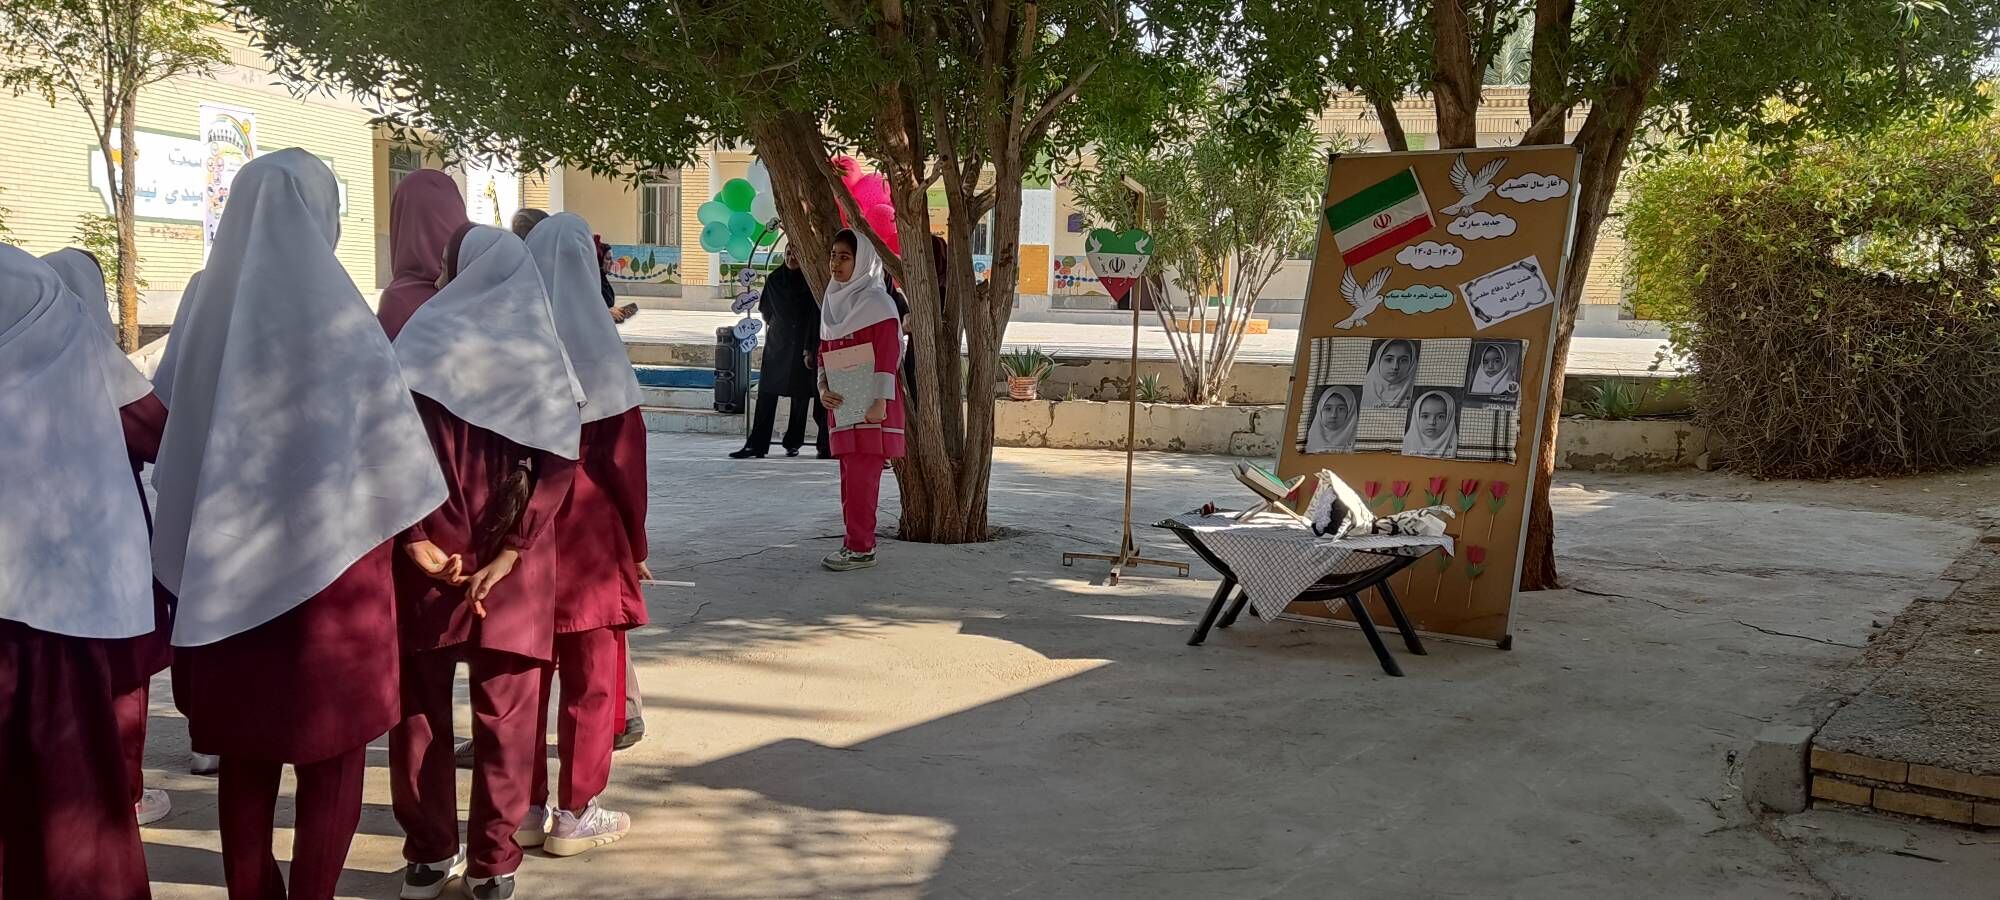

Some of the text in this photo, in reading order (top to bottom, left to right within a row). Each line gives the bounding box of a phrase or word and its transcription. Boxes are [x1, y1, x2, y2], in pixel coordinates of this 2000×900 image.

[1501, 179, 1562, 192] آغاز سال تحصیلی
[1481, 219, 1501, 228] جدید
[743, 271, 756, 282] سال
[1490, 284, 1504, 295] دفاع
[1504, 280, 1517, 290] سال
[1508, 288, 1527, 302] گرامی
[736, 293, 759, 310] تحصیلی
